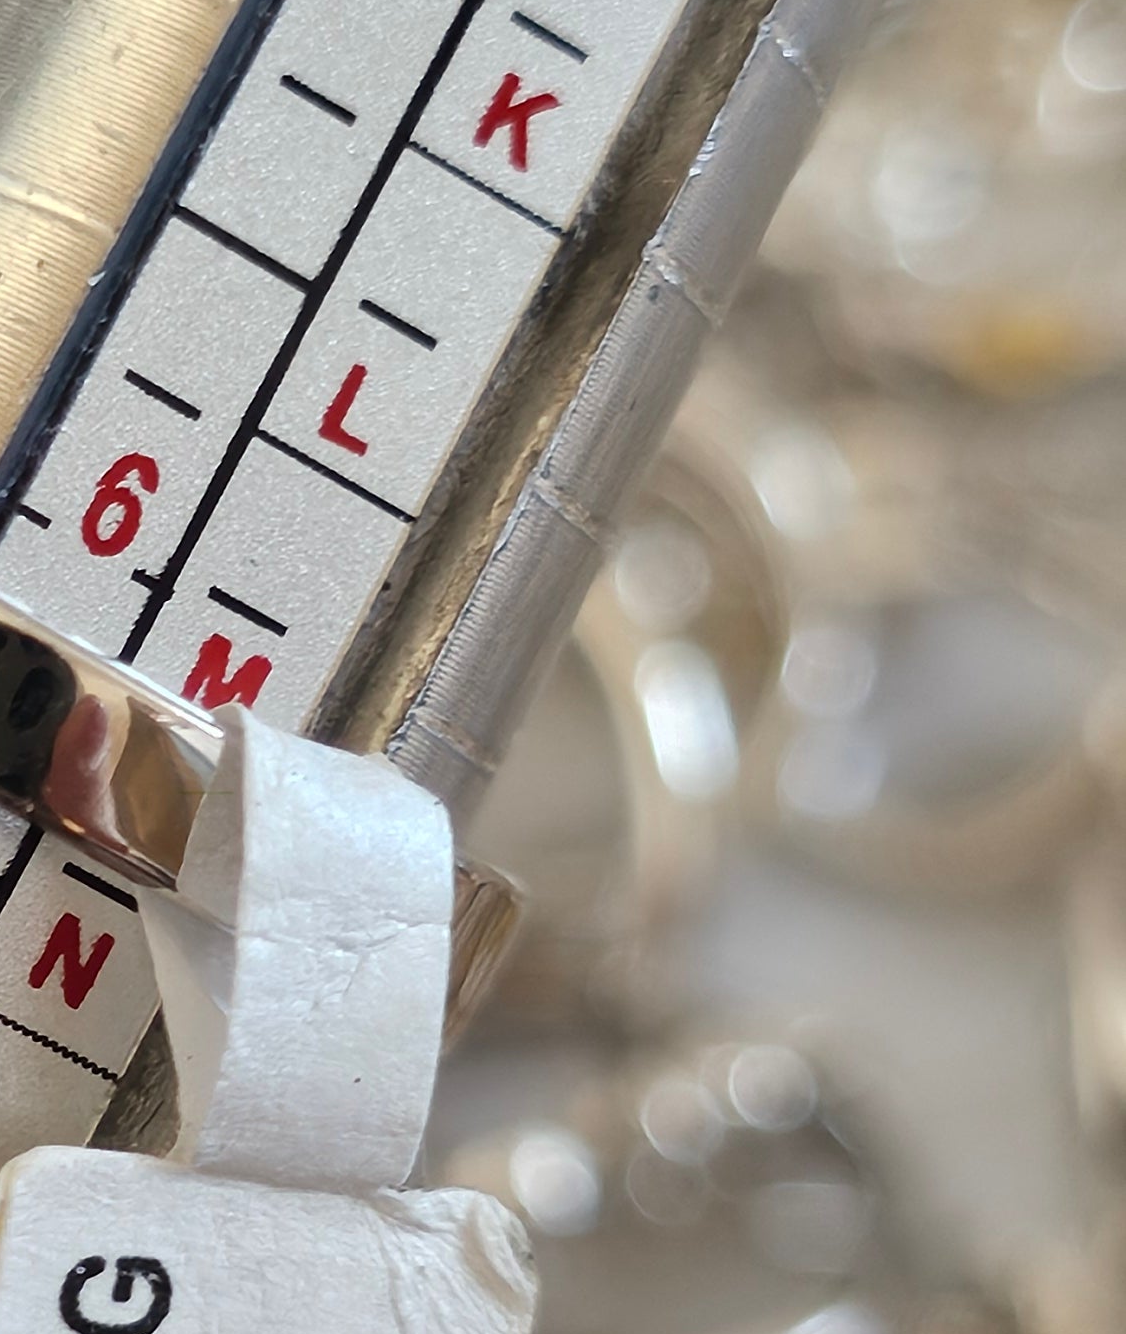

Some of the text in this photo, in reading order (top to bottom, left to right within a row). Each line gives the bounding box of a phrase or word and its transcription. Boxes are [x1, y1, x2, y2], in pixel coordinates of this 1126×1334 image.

[476, 73, 559, 169] K
[319, 364, 368, 456] L
[80, 451, 161, 558] 6
[180, 632, 273, 711] M
[28, 912, 115, 1009] N
